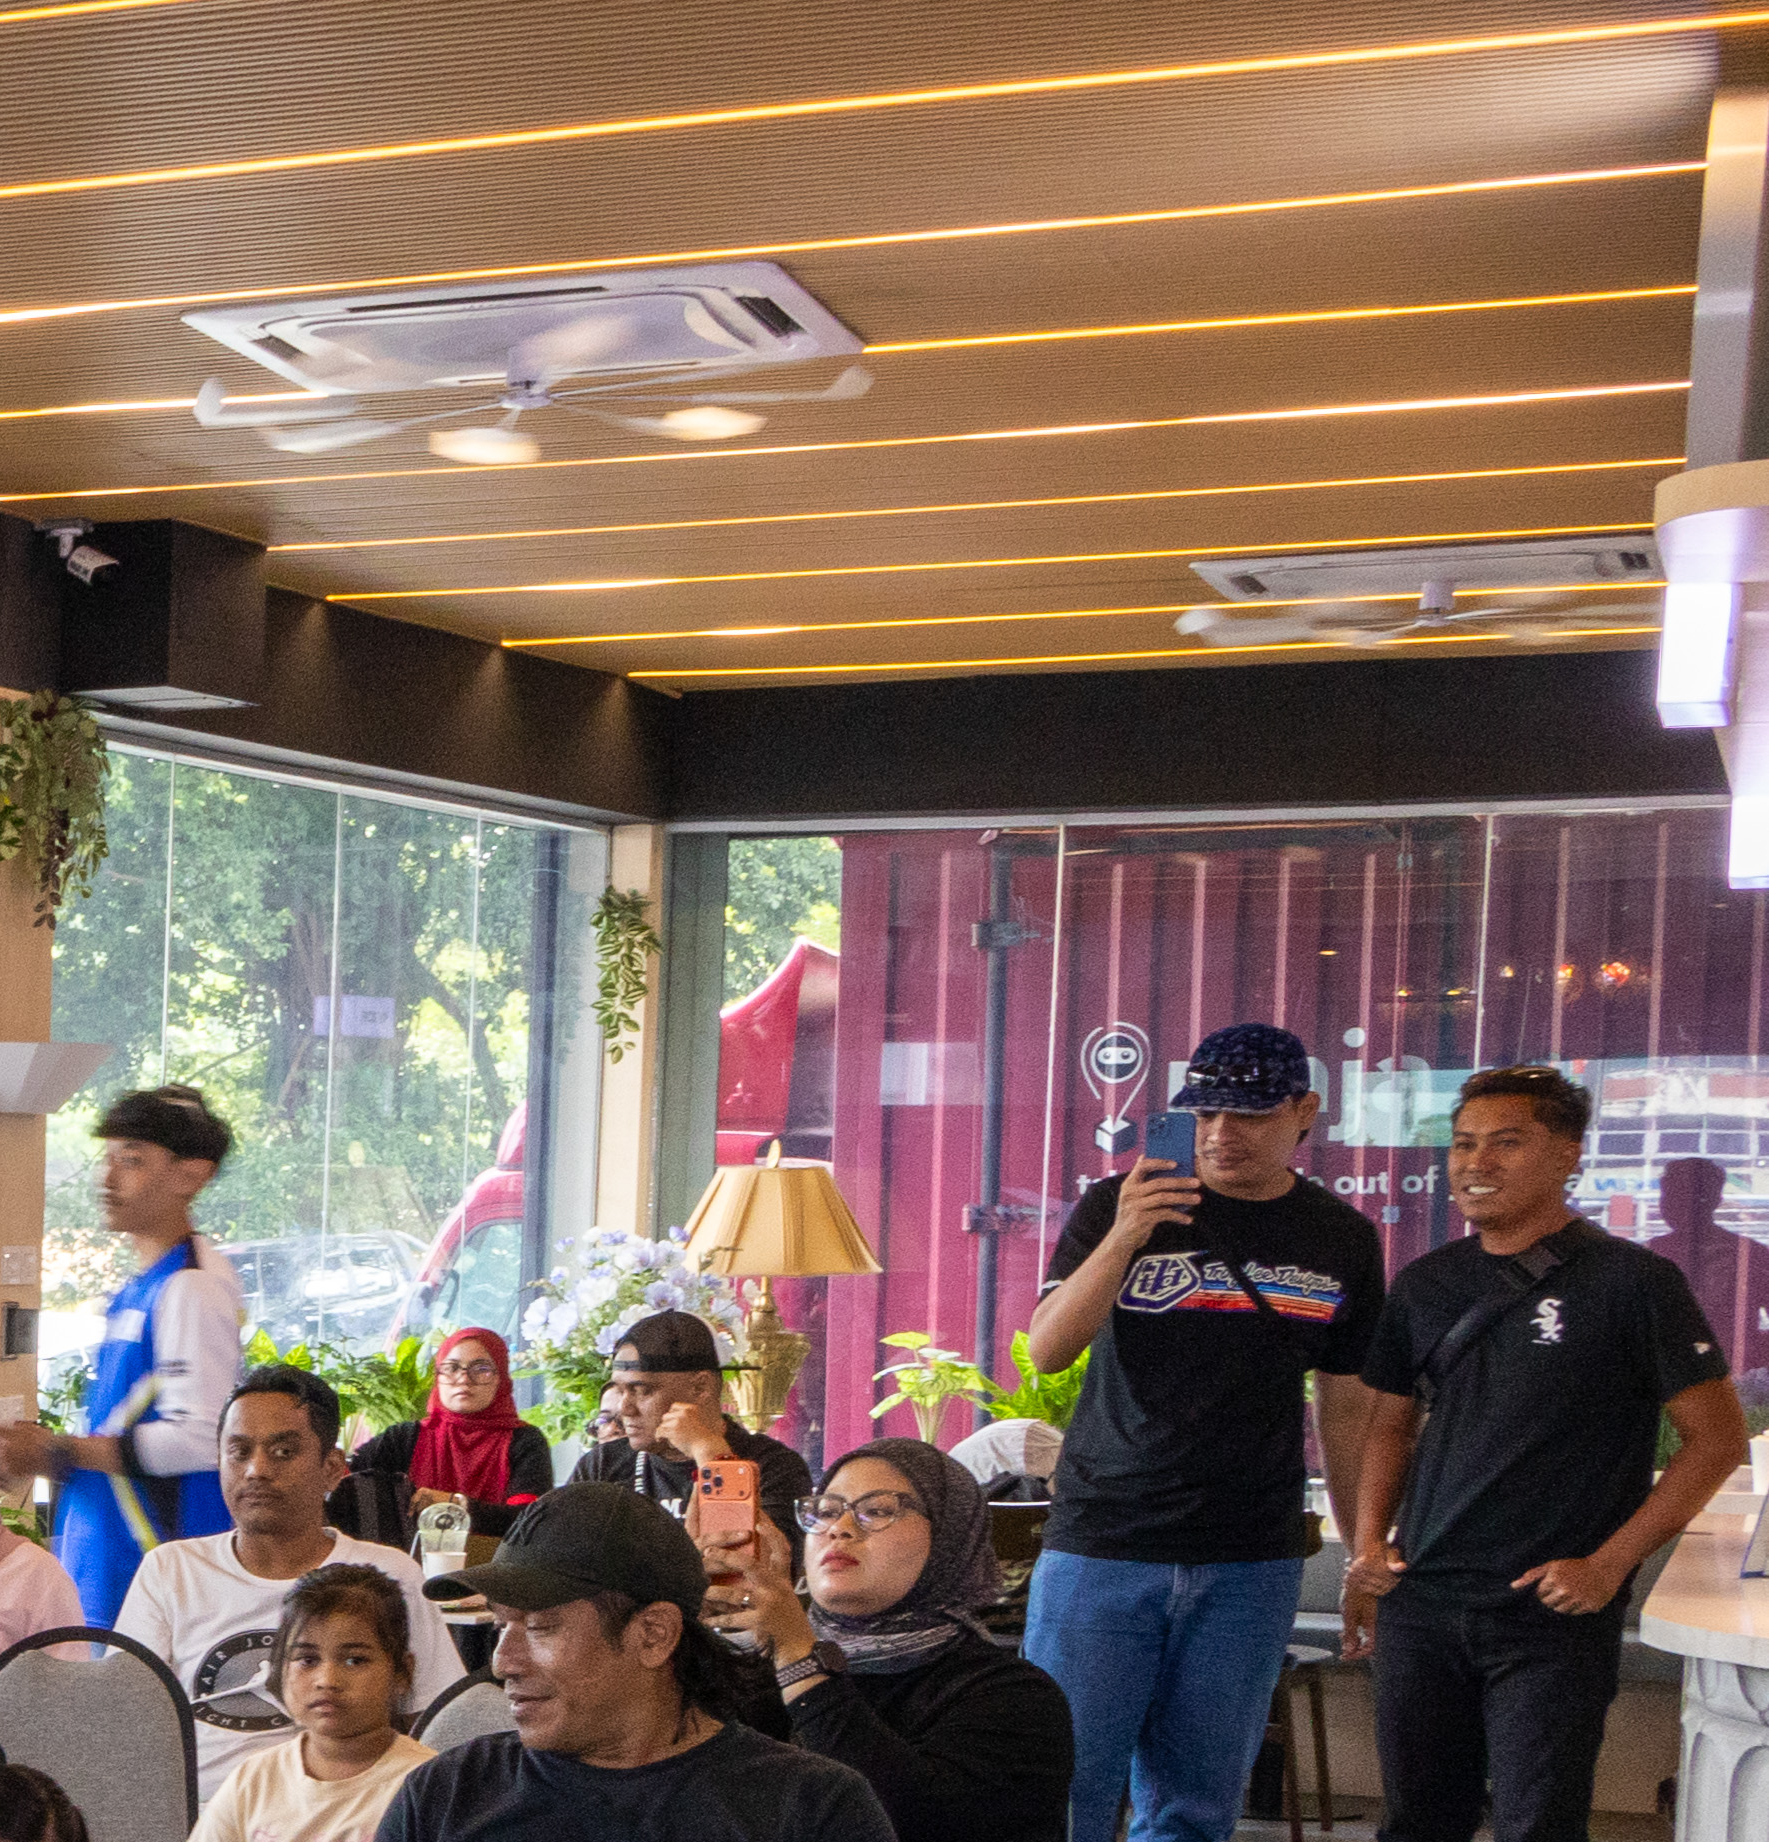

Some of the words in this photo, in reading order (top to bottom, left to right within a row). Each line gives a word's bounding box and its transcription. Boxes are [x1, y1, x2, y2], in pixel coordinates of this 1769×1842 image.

[1334, 1170, 1389, 1196] out
[1402, 1166, 1440, 1195] of
[201, 1650, 227, 1686] AIR
